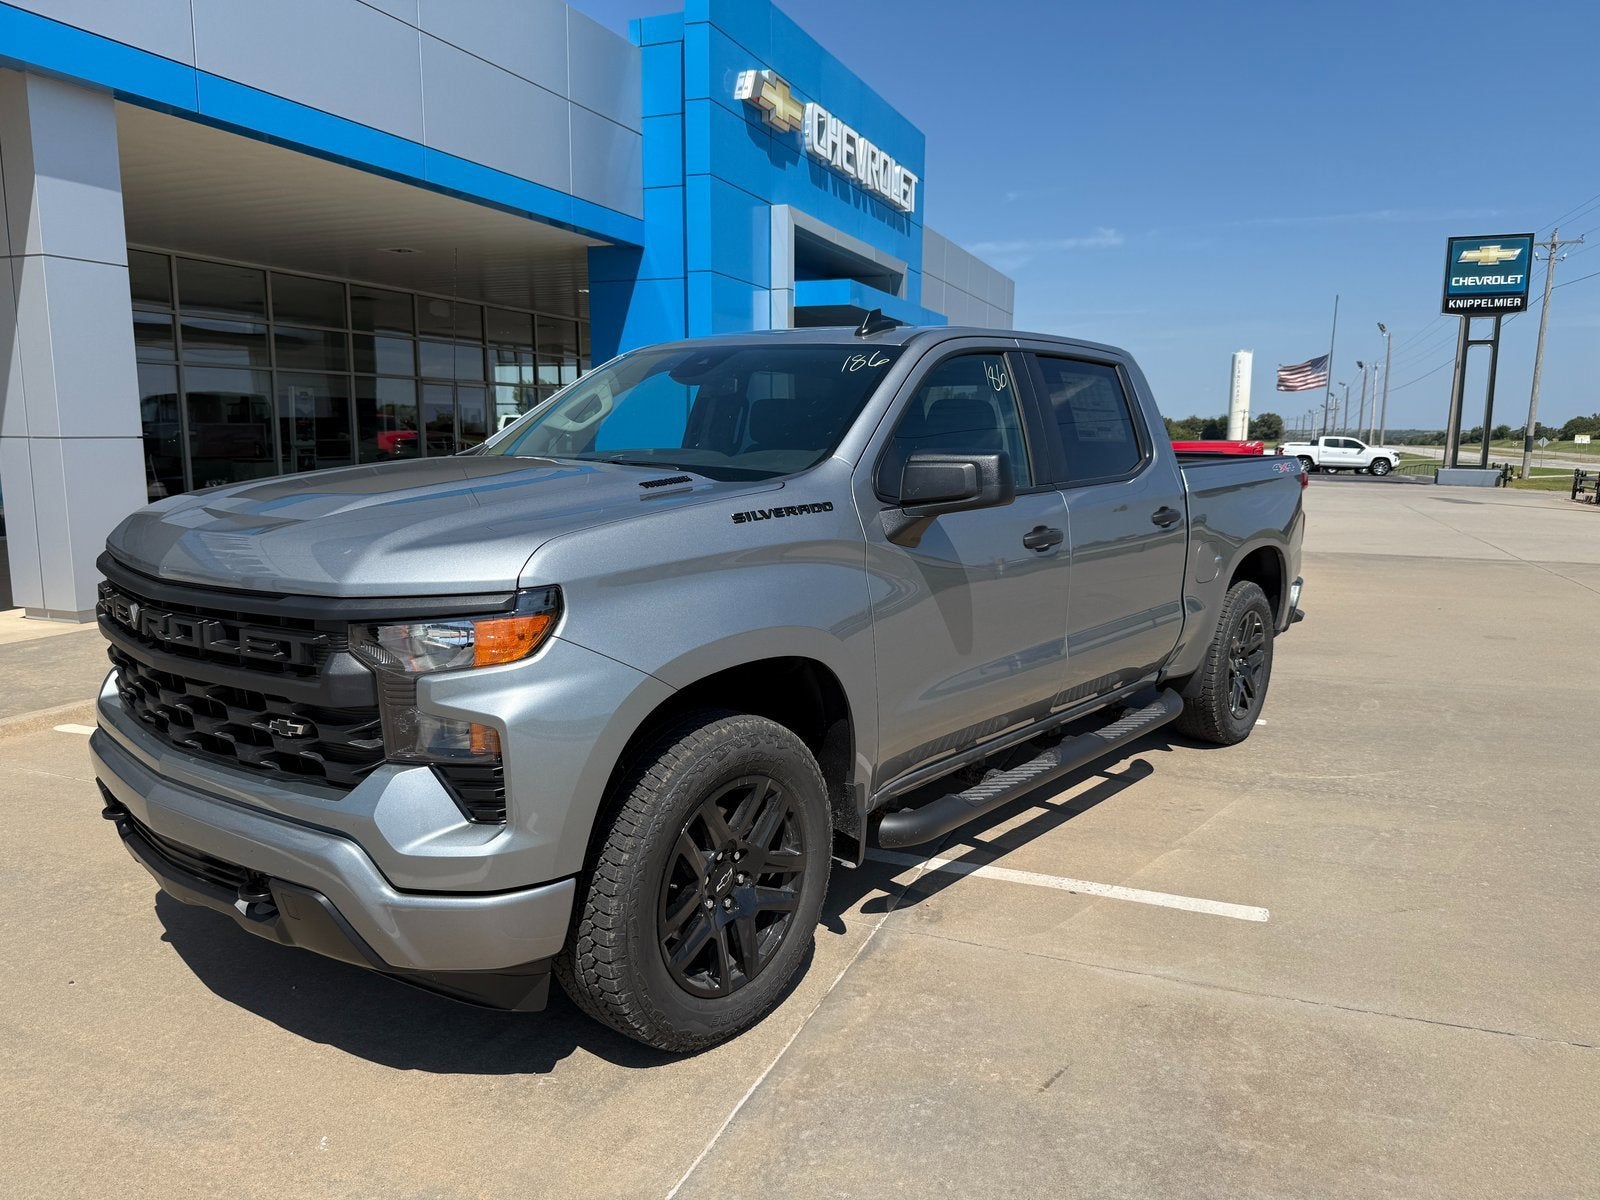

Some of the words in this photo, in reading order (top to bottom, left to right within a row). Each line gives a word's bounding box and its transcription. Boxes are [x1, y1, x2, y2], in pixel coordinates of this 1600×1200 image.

[803, 102, 918, 213] CHEVROLET
[1452, 275, 1523, 286] CHEVROLET
[1448, 298, 1521, 308] KNIPPELMIER
[841, 350, 890, 373] 186
[982, 360, 1008, 392] 186
[732, 501, 834, 524] SILVERADO
